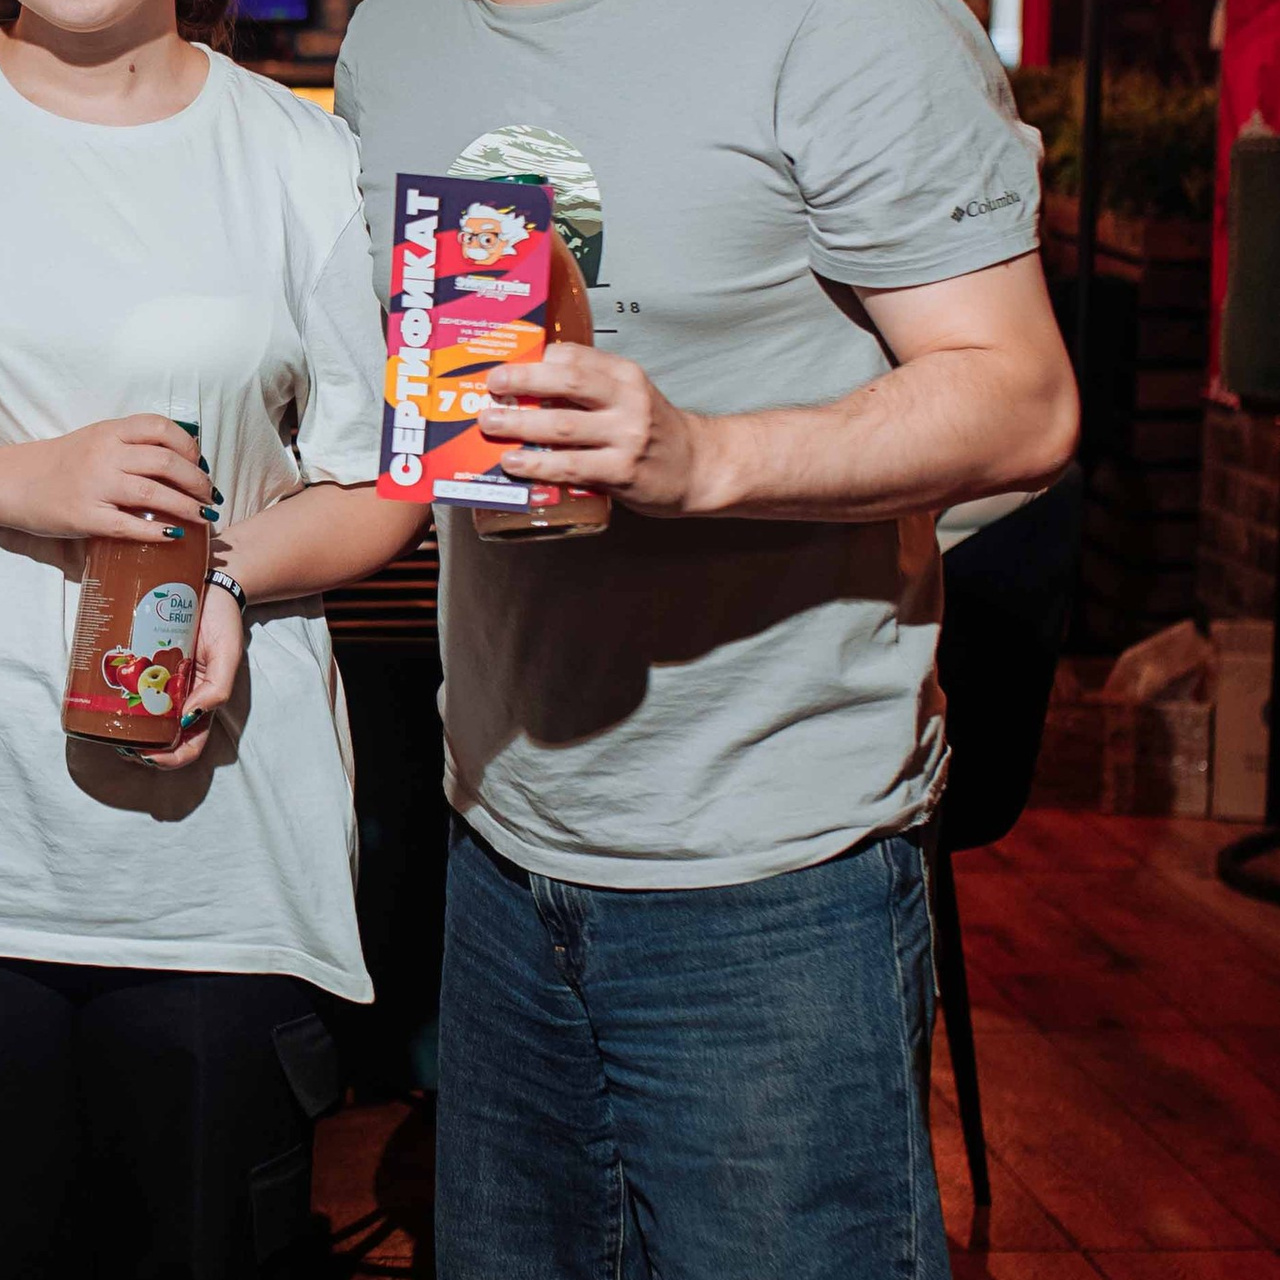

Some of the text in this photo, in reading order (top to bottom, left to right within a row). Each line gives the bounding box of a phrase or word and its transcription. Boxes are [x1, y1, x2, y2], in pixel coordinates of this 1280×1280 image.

[389, 188, 440, 487] СЕРТИФИКАТ
[170, 598, 193, 609] DALA
[169, 612, 193, 624] FRUIT
